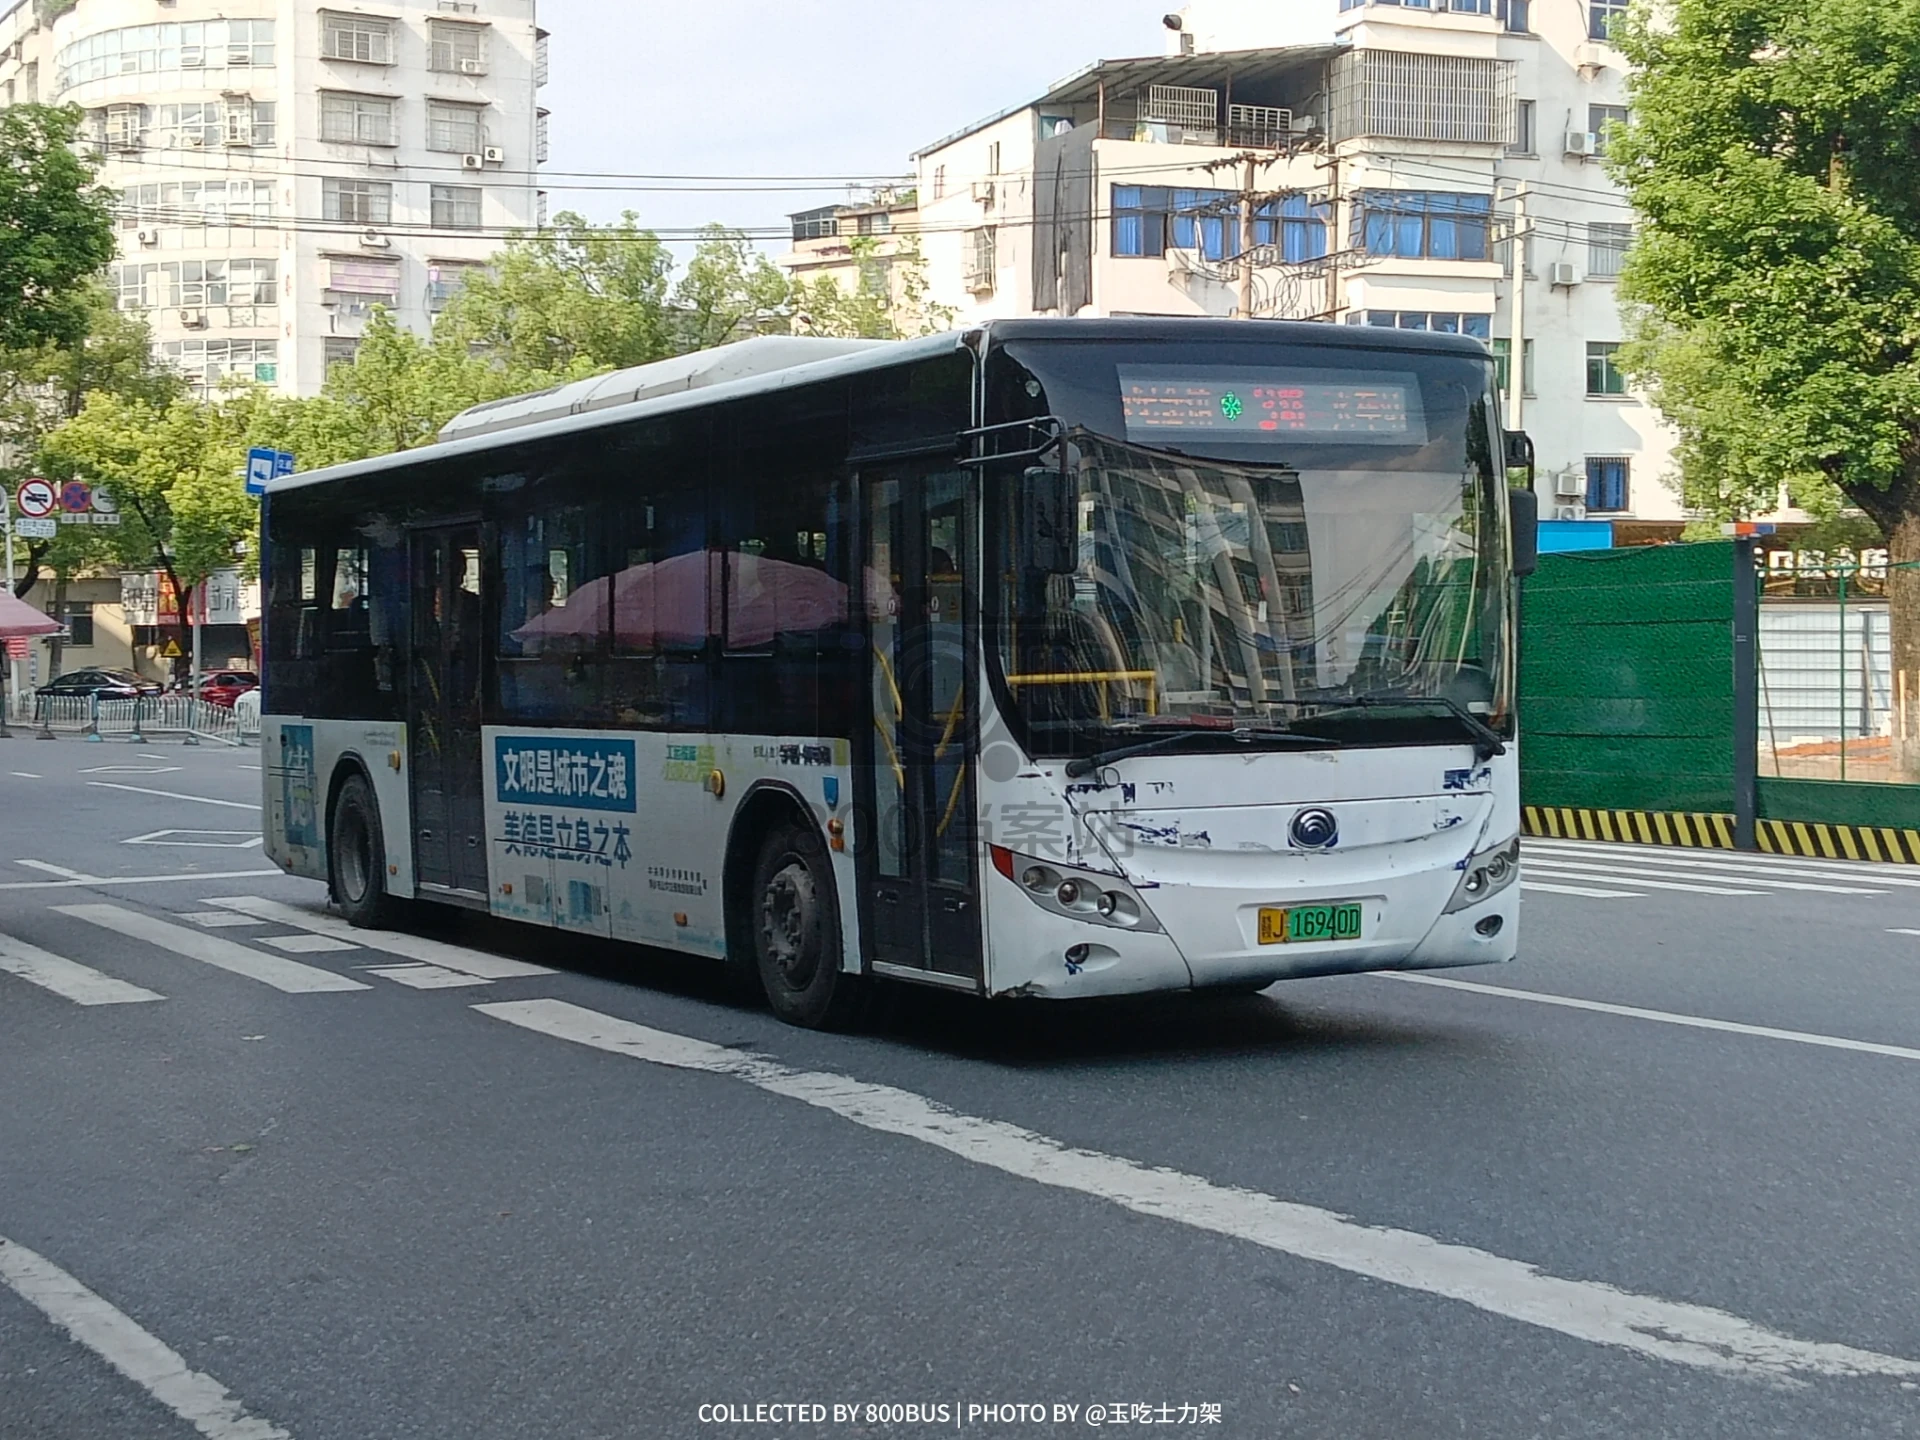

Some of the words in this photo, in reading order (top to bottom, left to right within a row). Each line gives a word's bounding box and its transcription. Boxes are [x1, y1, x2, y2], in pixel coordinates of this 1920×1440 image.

[502, 748, 628, 800] 文明是城市之魂
[504, 811, 633, 870] 美德是立身之本
